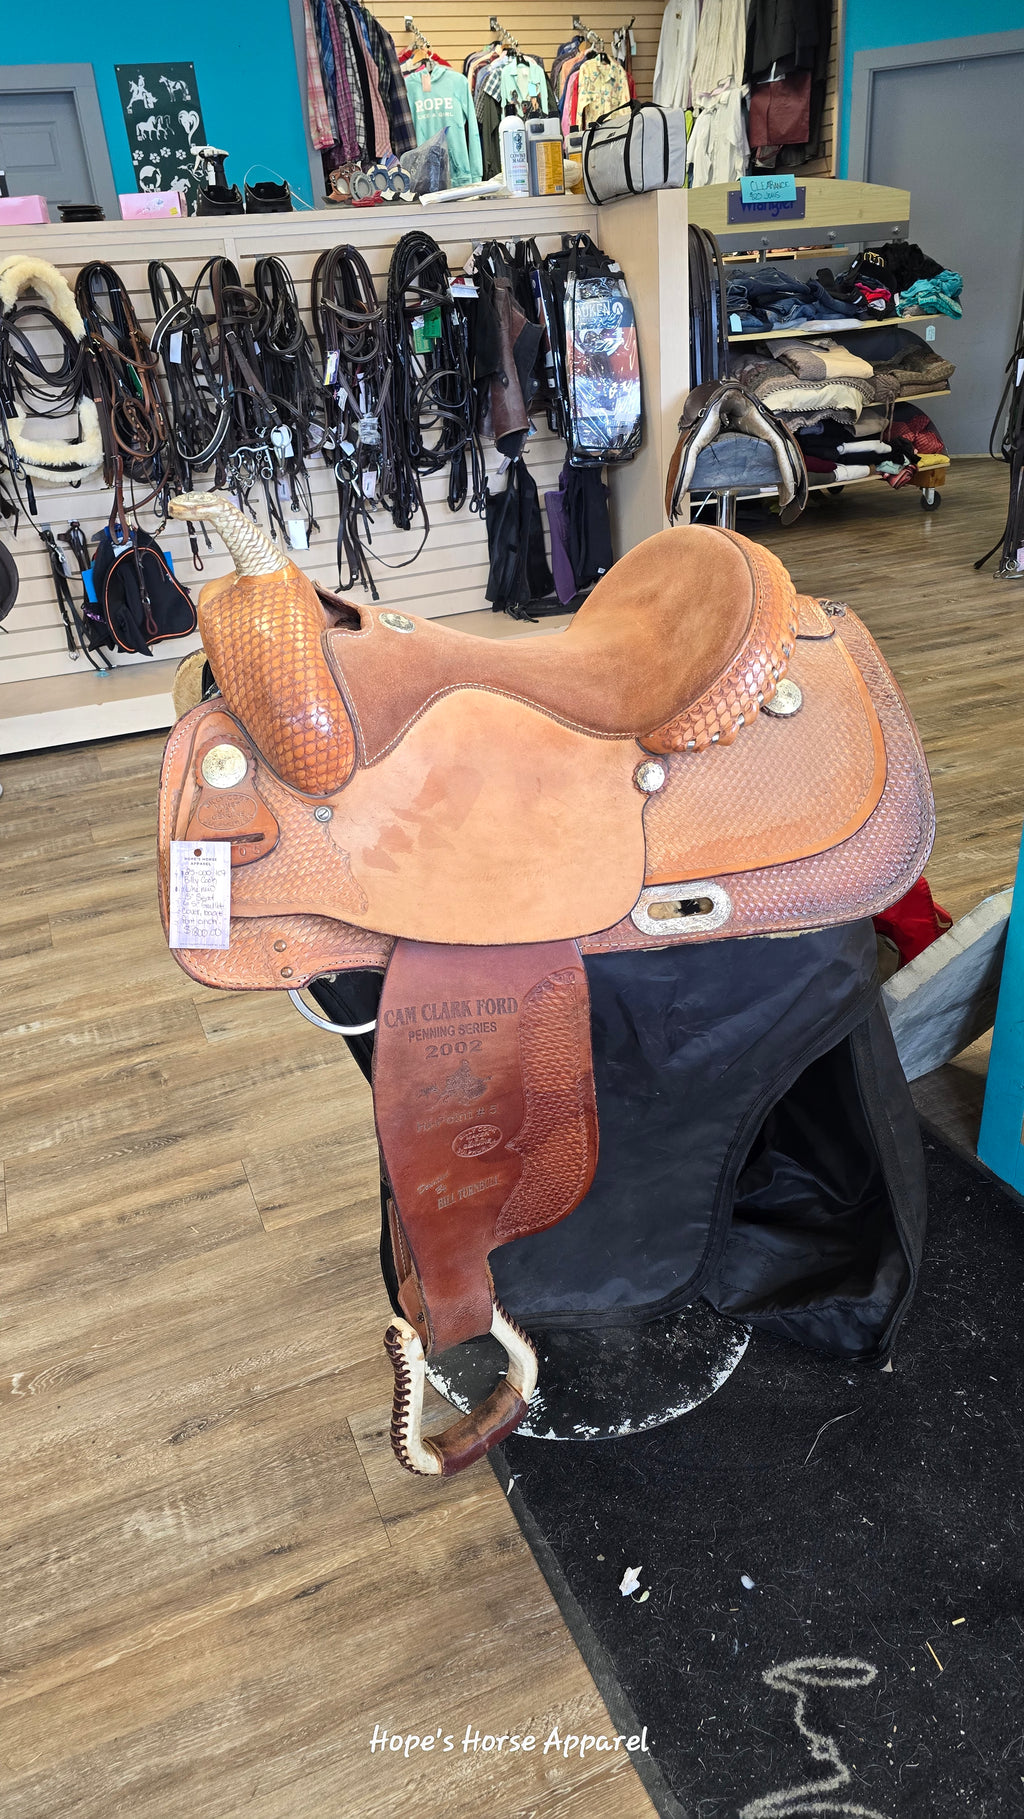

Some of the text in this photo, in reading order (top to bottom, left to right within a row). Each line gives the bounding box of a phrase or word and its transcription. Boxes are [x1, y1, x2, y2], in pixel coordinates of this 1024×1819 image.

[415, 98, 453, 112] ROPE
[384, 998, 518, 1028] CAM CLARK FORD
[408, 1022, 497, 1043] PENNING SERIES
[425, 1040, 483, 1060] 2002
